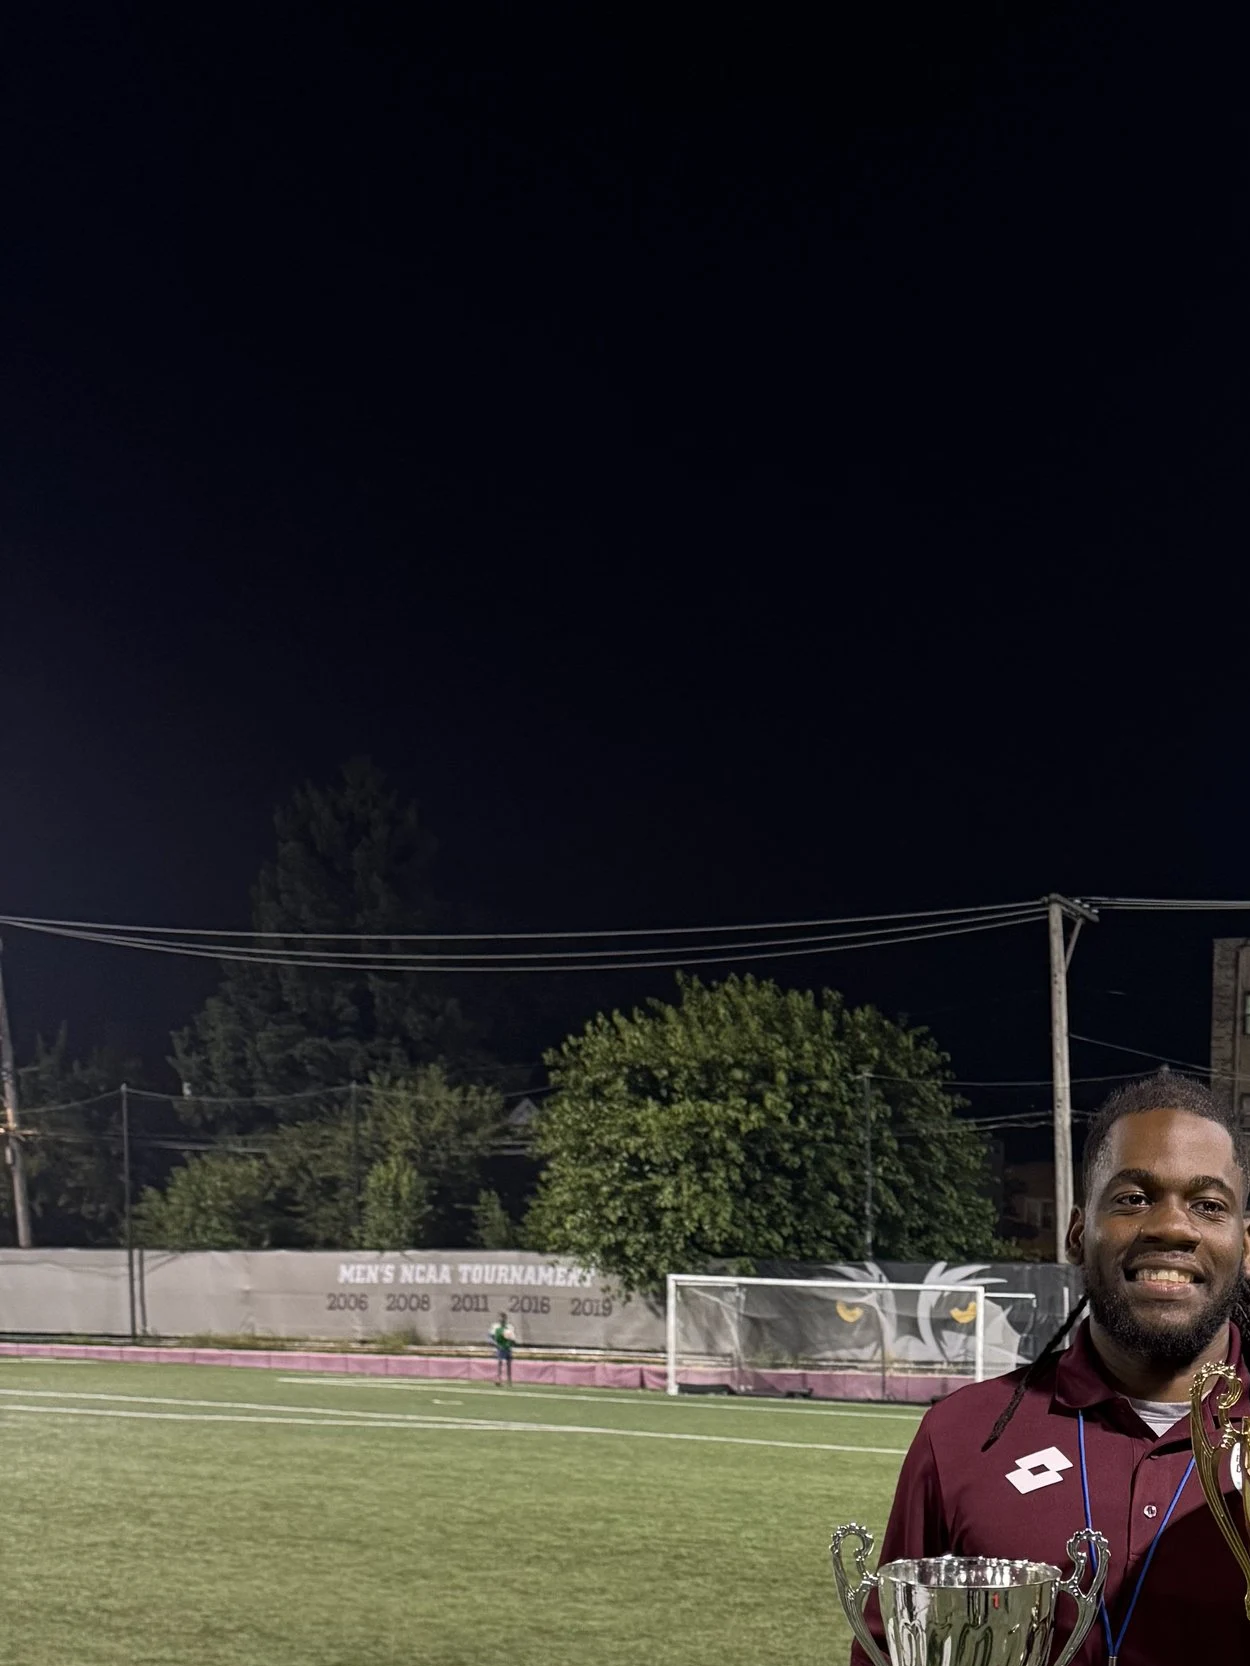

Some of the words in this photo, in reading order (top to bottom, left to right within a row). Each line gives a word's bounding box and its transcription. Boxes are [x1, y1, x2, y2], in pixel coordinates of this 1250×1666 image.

[338, 1263, 394, 1284] MEN'S
[400, 1263, 451, 1285] NCAA
[458, 1264, 596, 1288] TOURNAMENT
[327, 1293, 369, 1312] 2006
[386, 1294, 431, 1312] 2008
[451, 1294, 490, 1313] 2011
[570, 1298, 613, 1317] 2019
